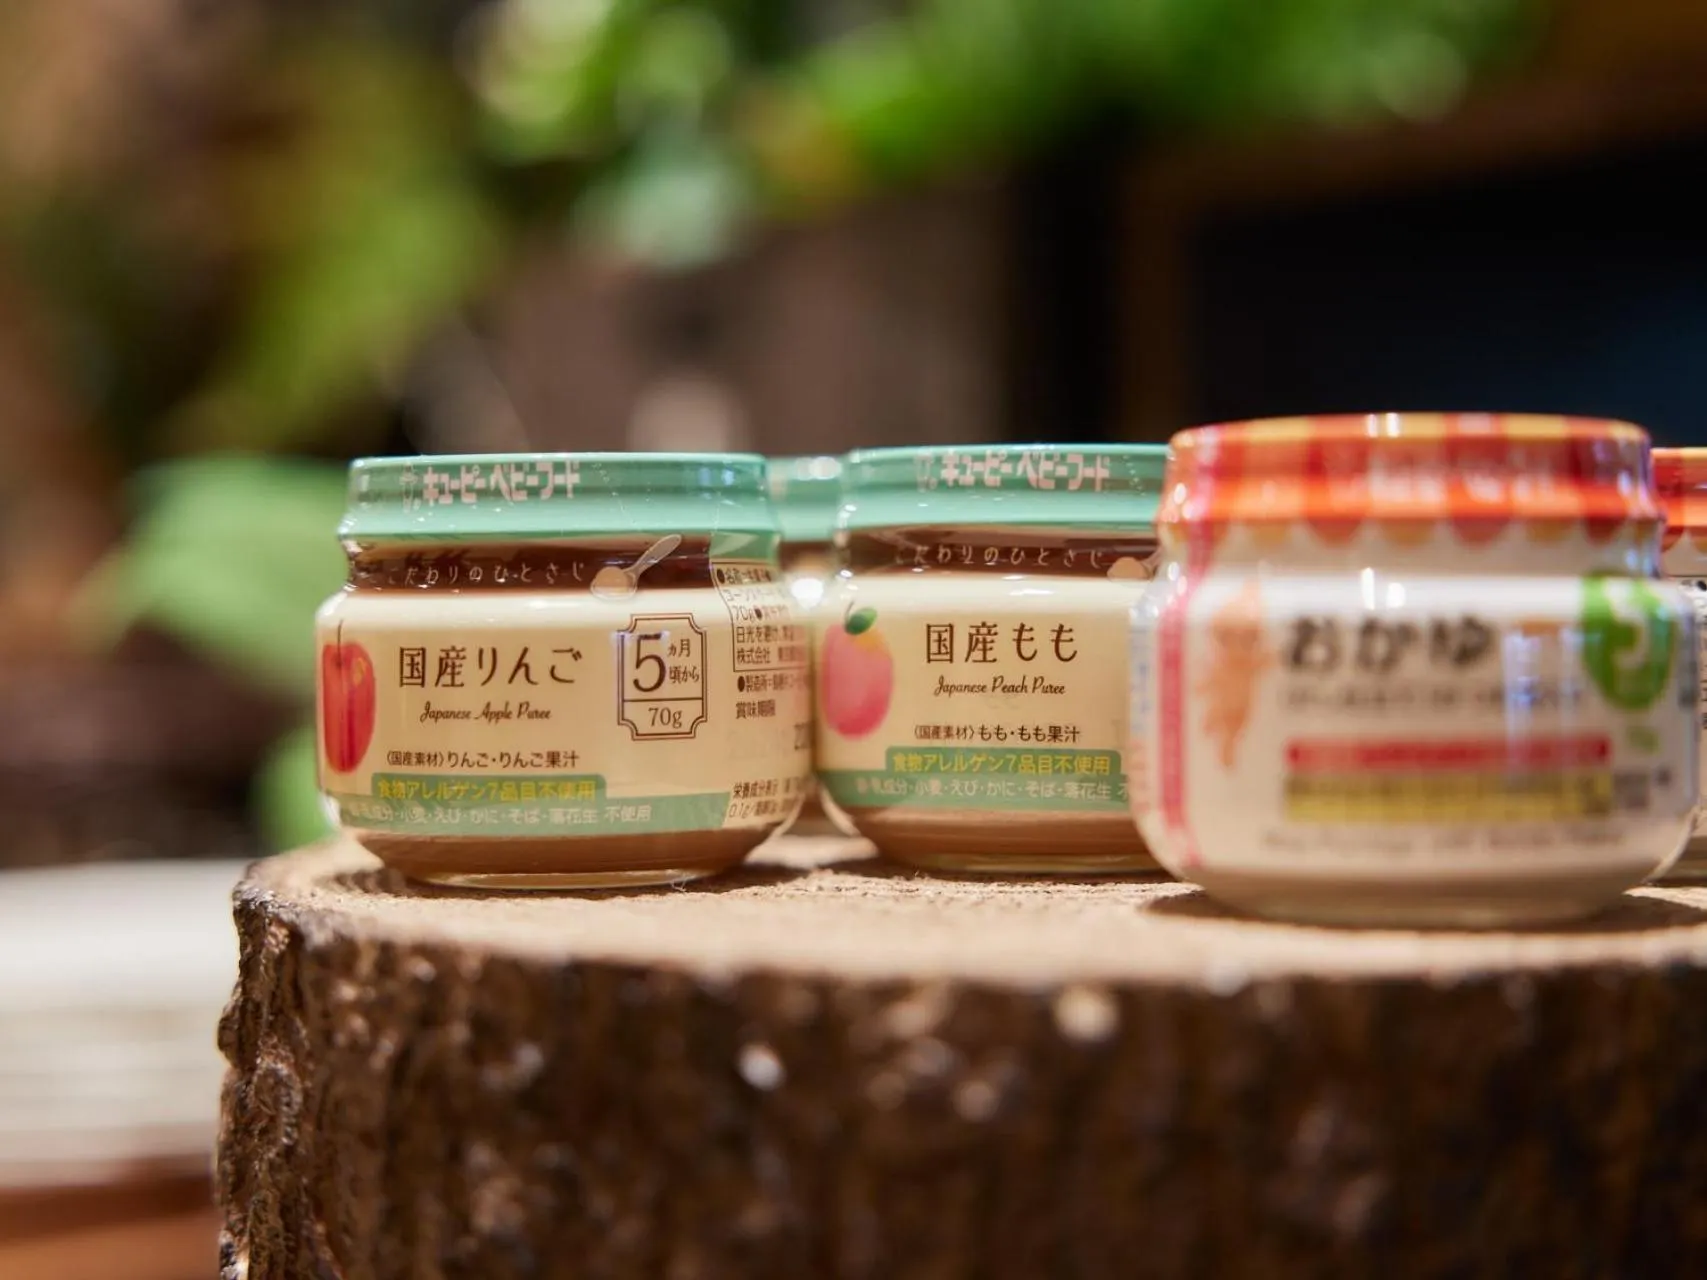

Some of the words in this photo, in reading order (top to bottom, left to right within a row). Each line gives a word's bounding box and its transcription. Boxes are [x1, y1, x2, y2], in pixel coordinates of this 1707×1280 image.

[926, 621, 1078, 664] 国産もも
[399, 646, 583, 689] 国産りんご
[633, 633, 667, 692] 5
[669, 666, 699, 684] 頃から
[934, 675, 987, 698] Japanese
[992, 675, 1028, 694] Peach
[1032, 676, 1065, 694] Puree
[420, 700, 472, 724] Japanese
[474, 701, 513, 724] Apple
[517, 702, 552, 720] Puree
[648, 707, 682, 729] 70g
[605, 804, 652, 824] 不使用
